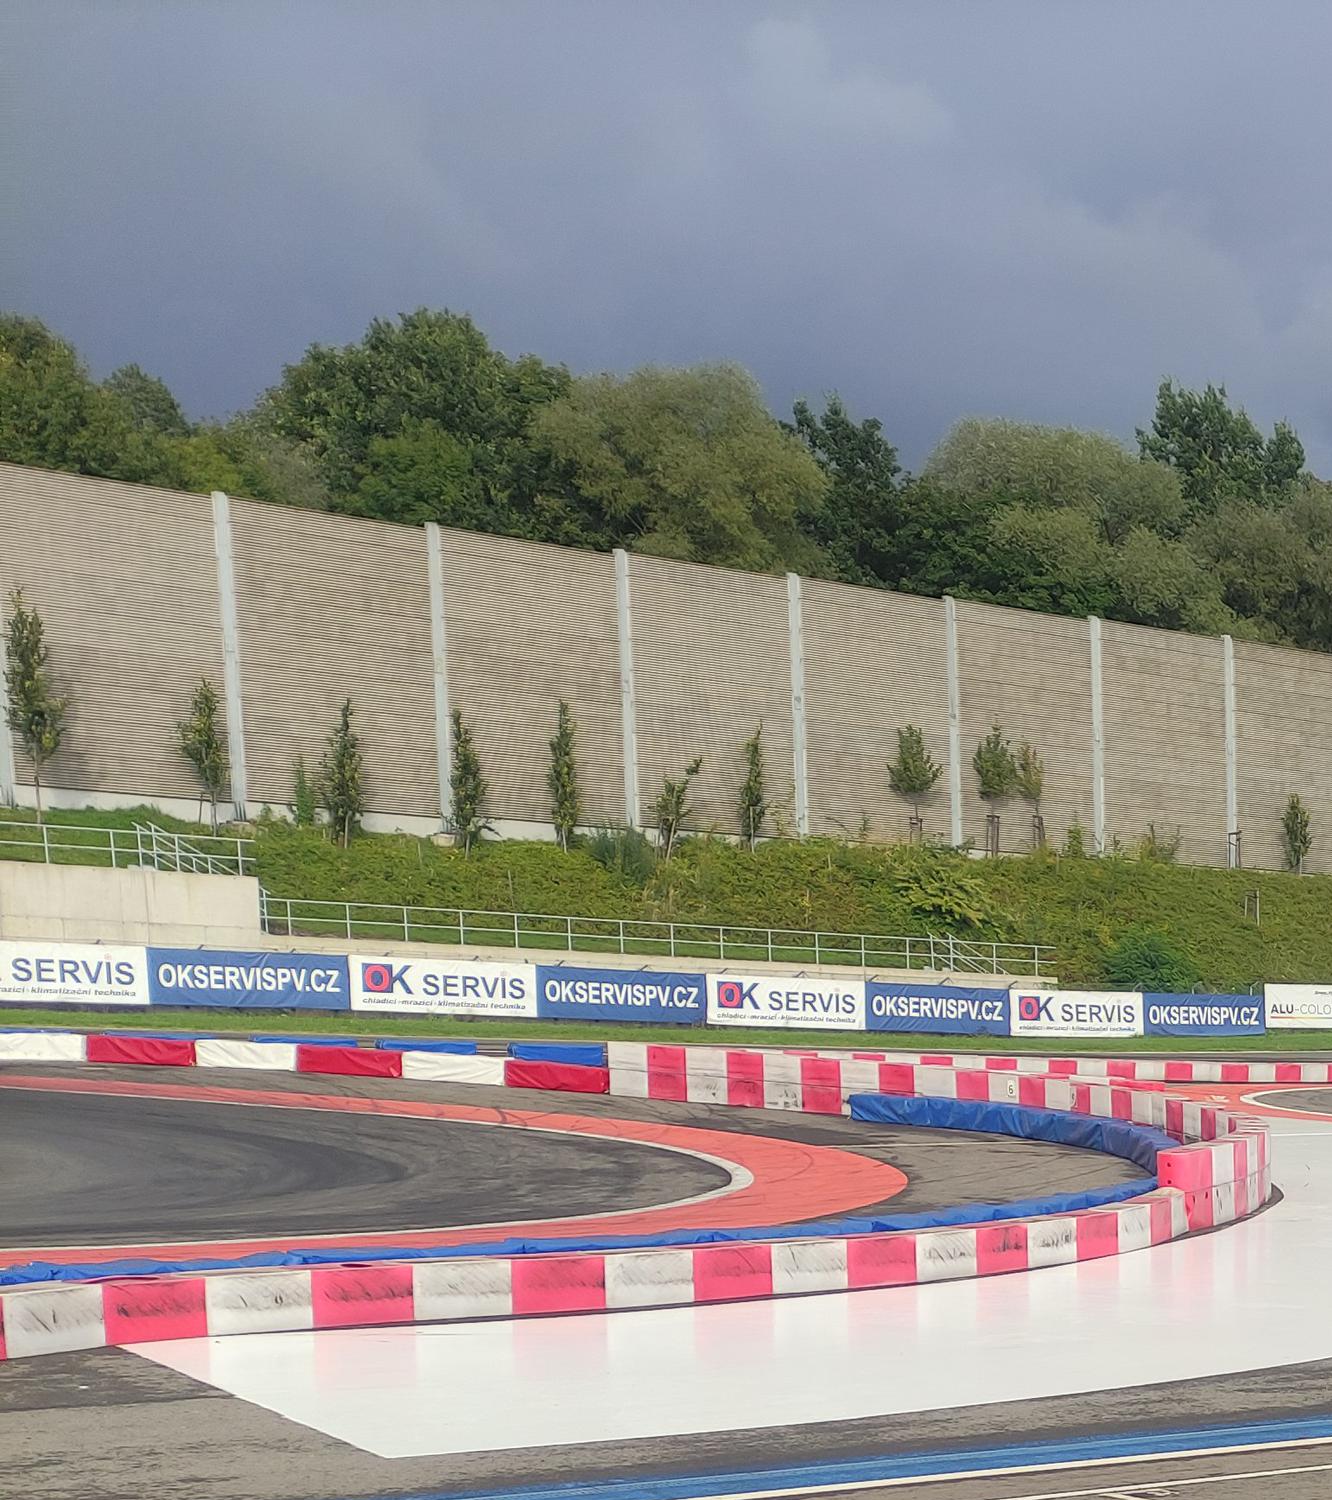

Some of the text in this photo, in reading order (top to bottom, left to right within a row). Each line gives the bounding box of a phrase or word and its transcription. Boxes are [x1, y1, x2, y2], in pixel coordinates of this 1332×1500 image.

[12, 957, 135, 985] SERVIS
[158, 963, 341, 993] OKSERVISPV.CZ
[362, 963, 526, 1000] OK SERVIS
[545, 980, 699, 1008] OKSERVISPV.CZ
[717, 981, 856, 1014] OK SERVIS
[872, 995, 1003, 1021] OKSERVISPV.CZ
[1019, 996, 1135, 1023] OK SERVIS
[1149, 1005, 1259, 1025] OKSERVISPV.CZ
